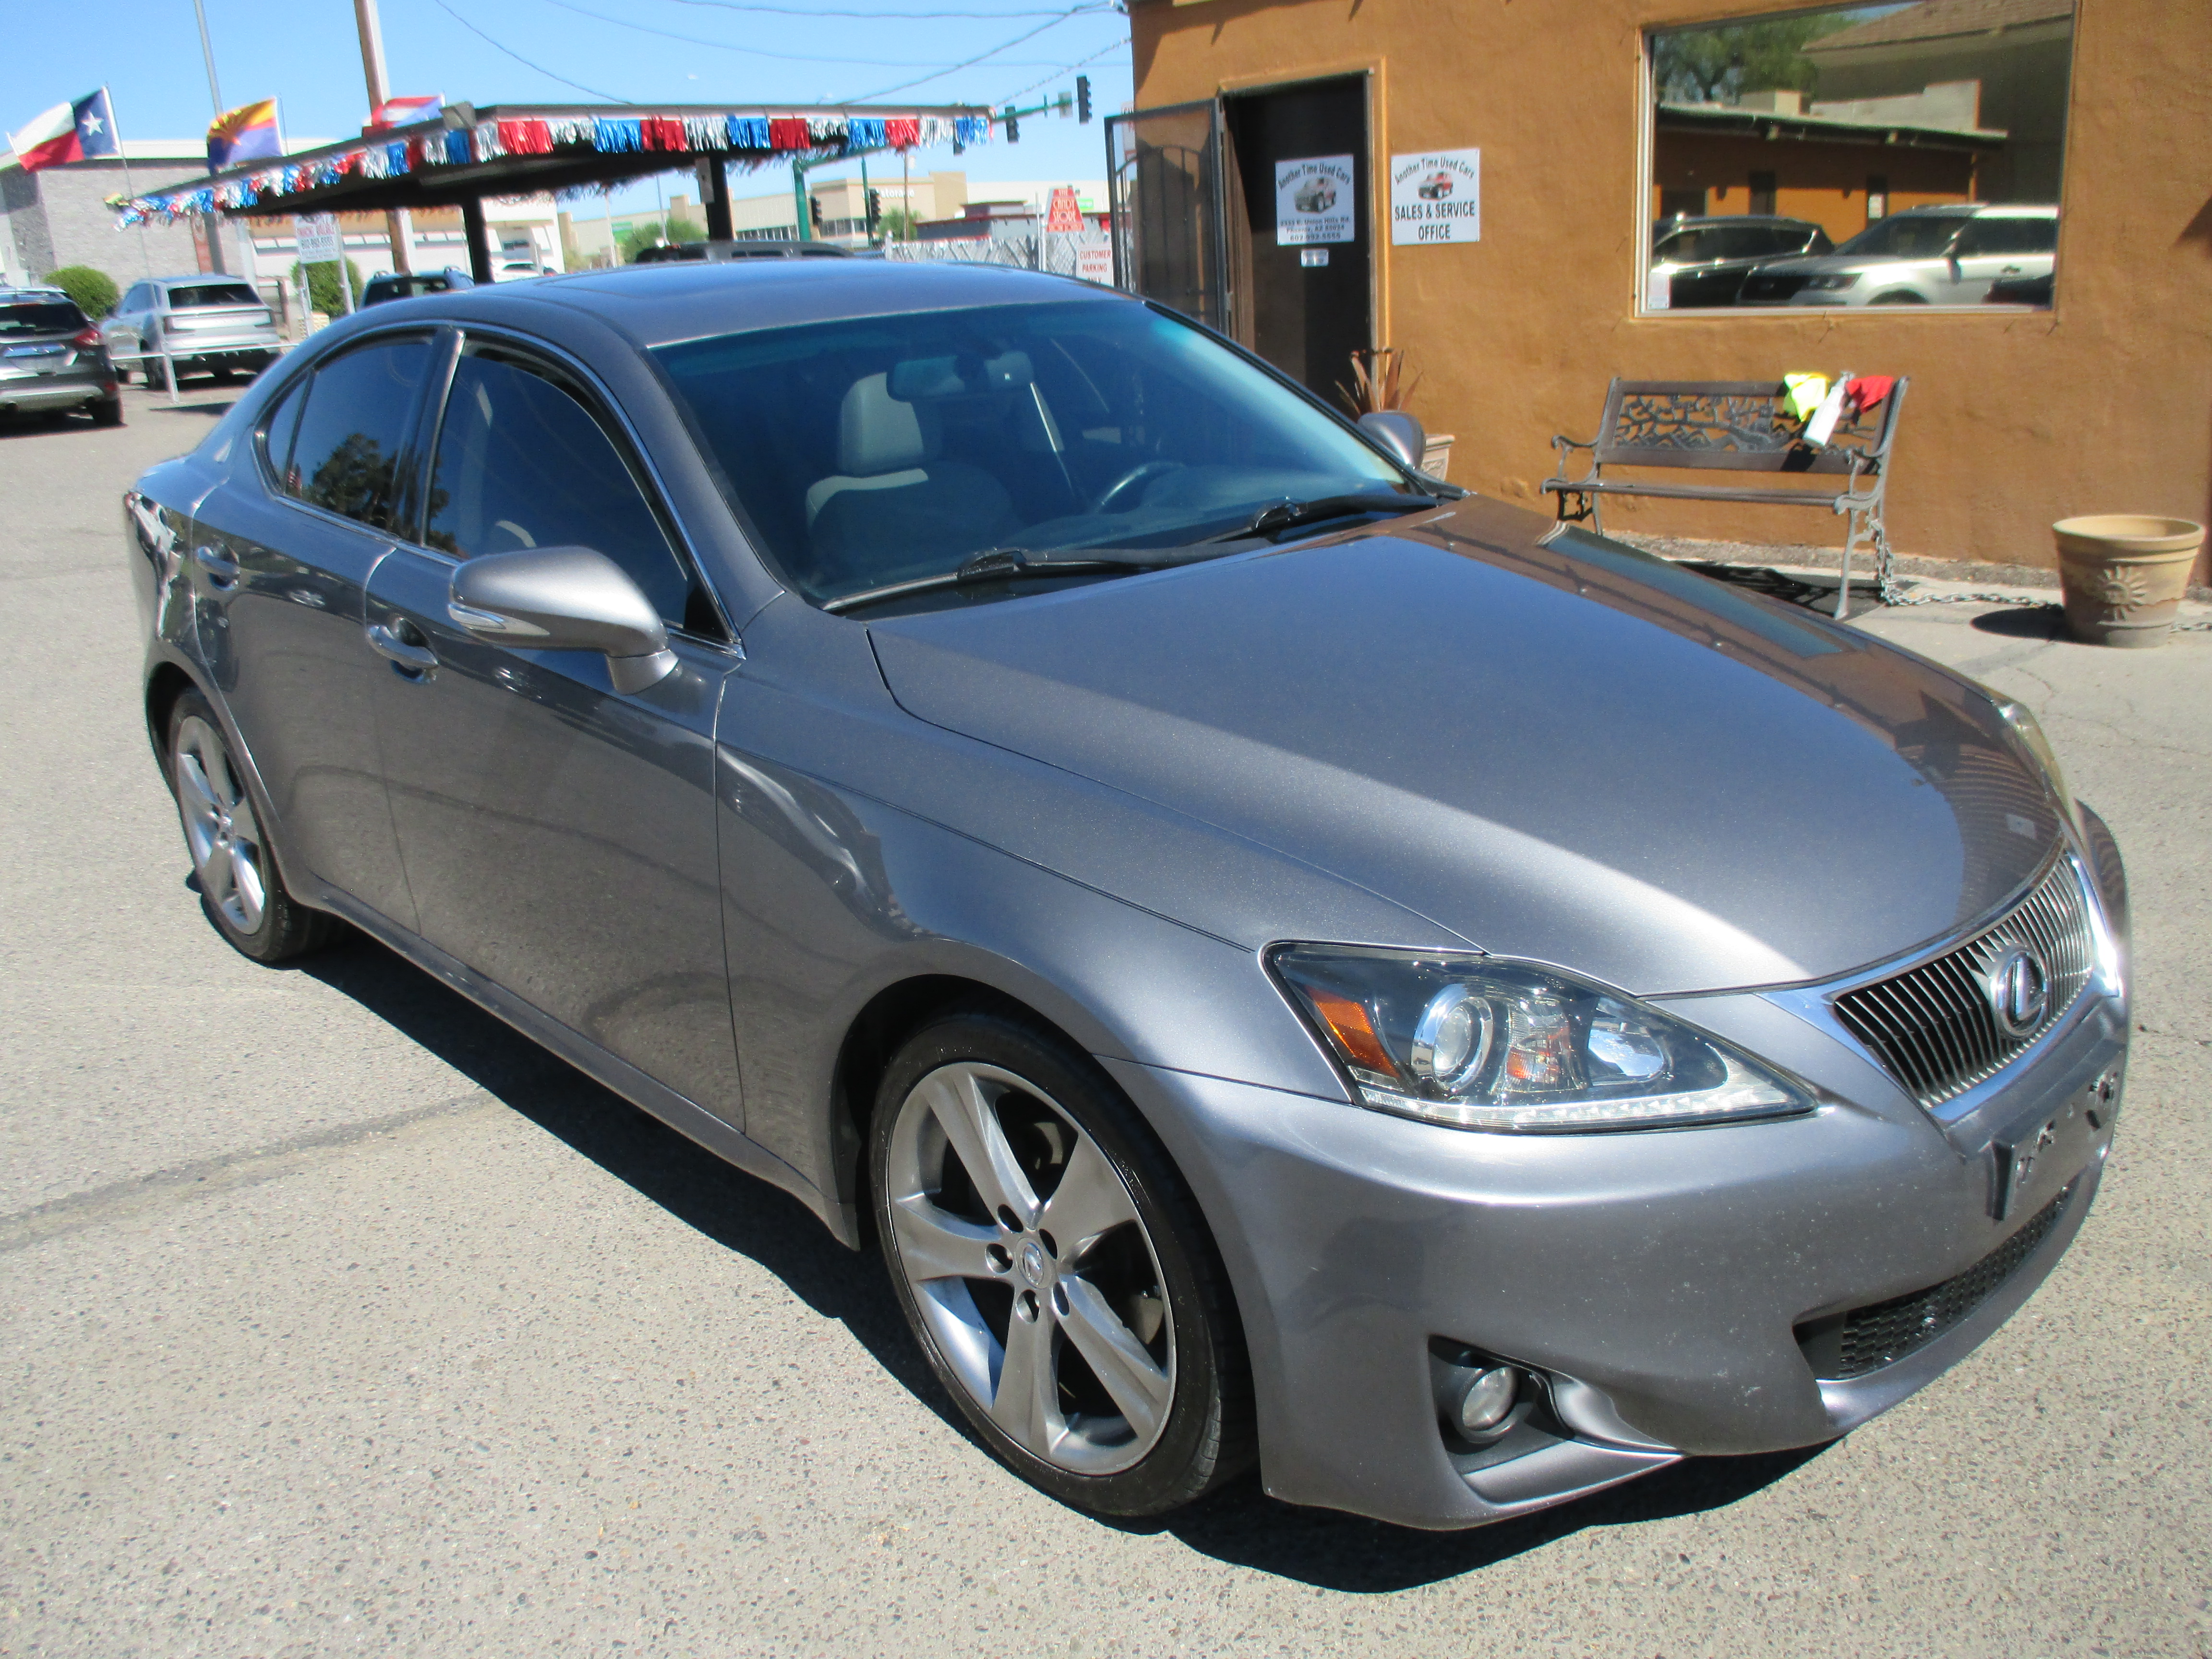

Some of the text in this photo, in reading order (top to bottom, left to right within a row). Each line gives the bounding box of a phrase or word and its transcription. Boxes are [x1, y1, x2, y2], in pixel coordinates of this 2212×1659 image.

[1394, 156, 1474, 185] Another Time Used Cars
[1278, 163, 1350, 191] Another Time Used Cars
[880, 188, 915, 198] storae
[1053, 198, 1075, 210] CANDY
[1052, 211, 1077, 223] STORE
[1395, 201, 1475, 221] SALES & SERVICE
[1418, 224, 1451, 240] OFFICE
[1080, 249, 1111, 260] CUSTOMER
[1082, 264, 1107, 273] PARKING
